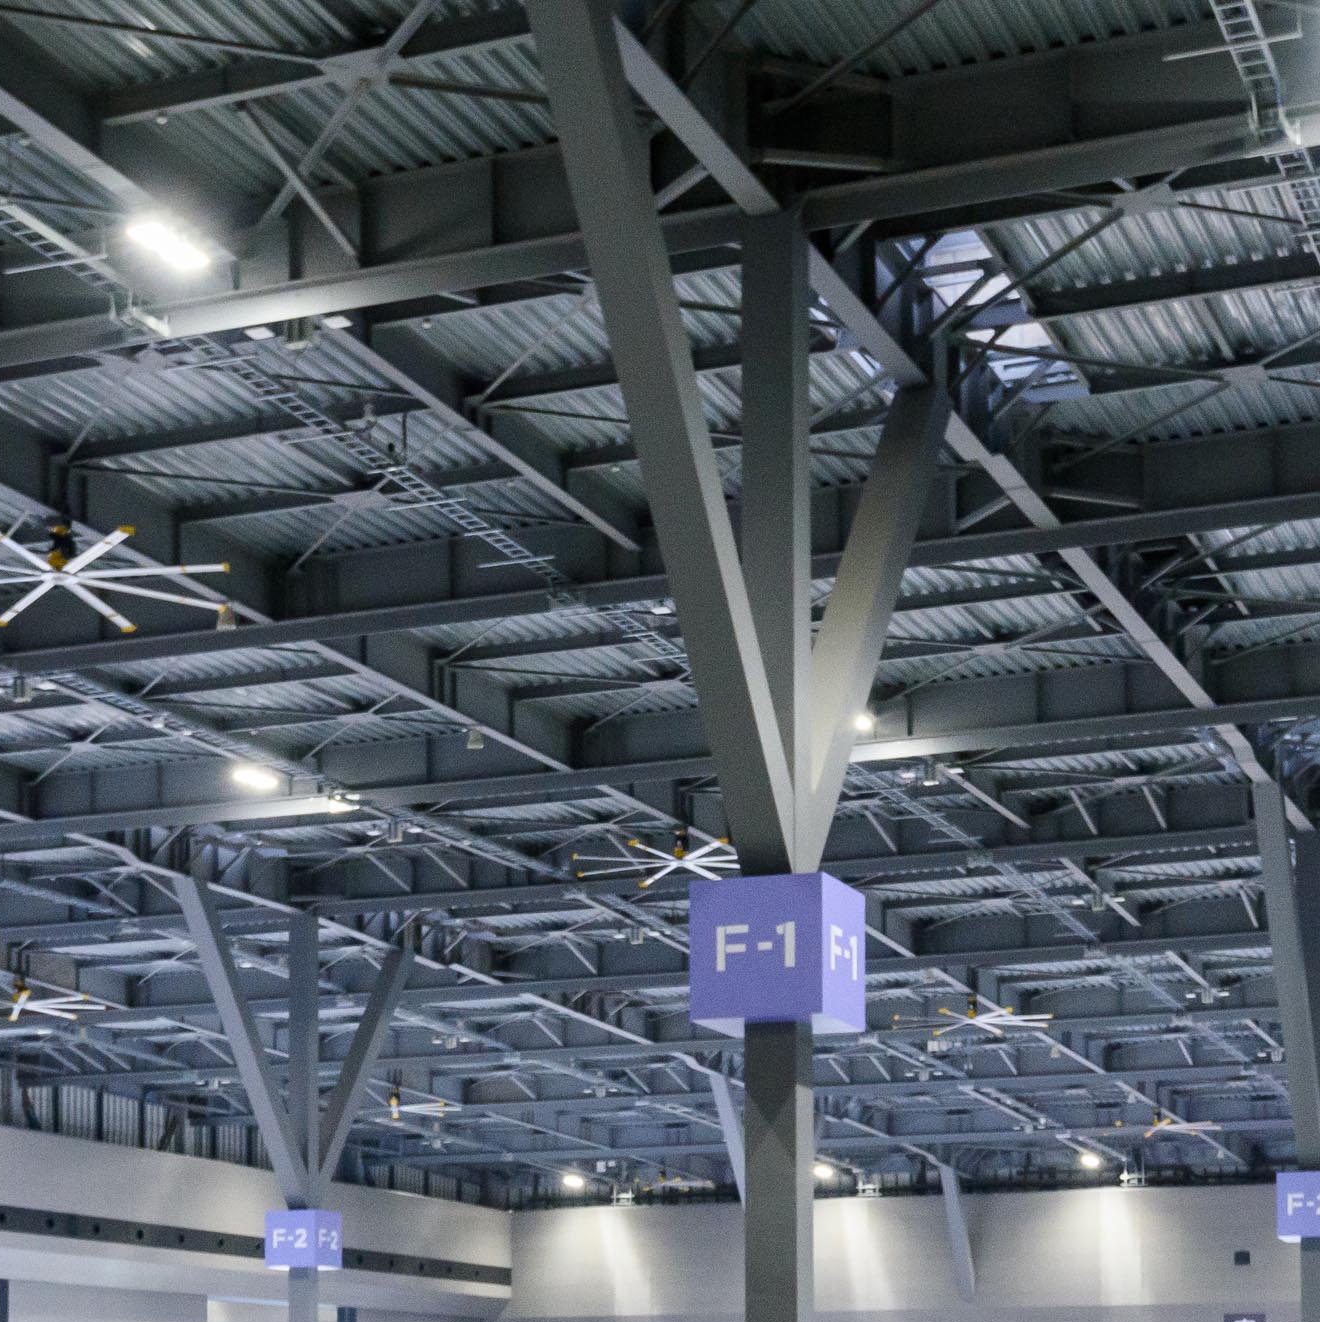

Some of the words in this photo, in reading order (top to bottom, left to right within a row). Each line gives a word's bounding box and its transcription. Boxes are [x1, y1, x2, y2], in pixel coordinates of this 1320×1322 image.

[715, 921, 796, 973] F-1
[830, 924, 858, 981] F-1
[272, 1228, 308, 1249] F-2
[318, 1229, 338, 1251] F-2
